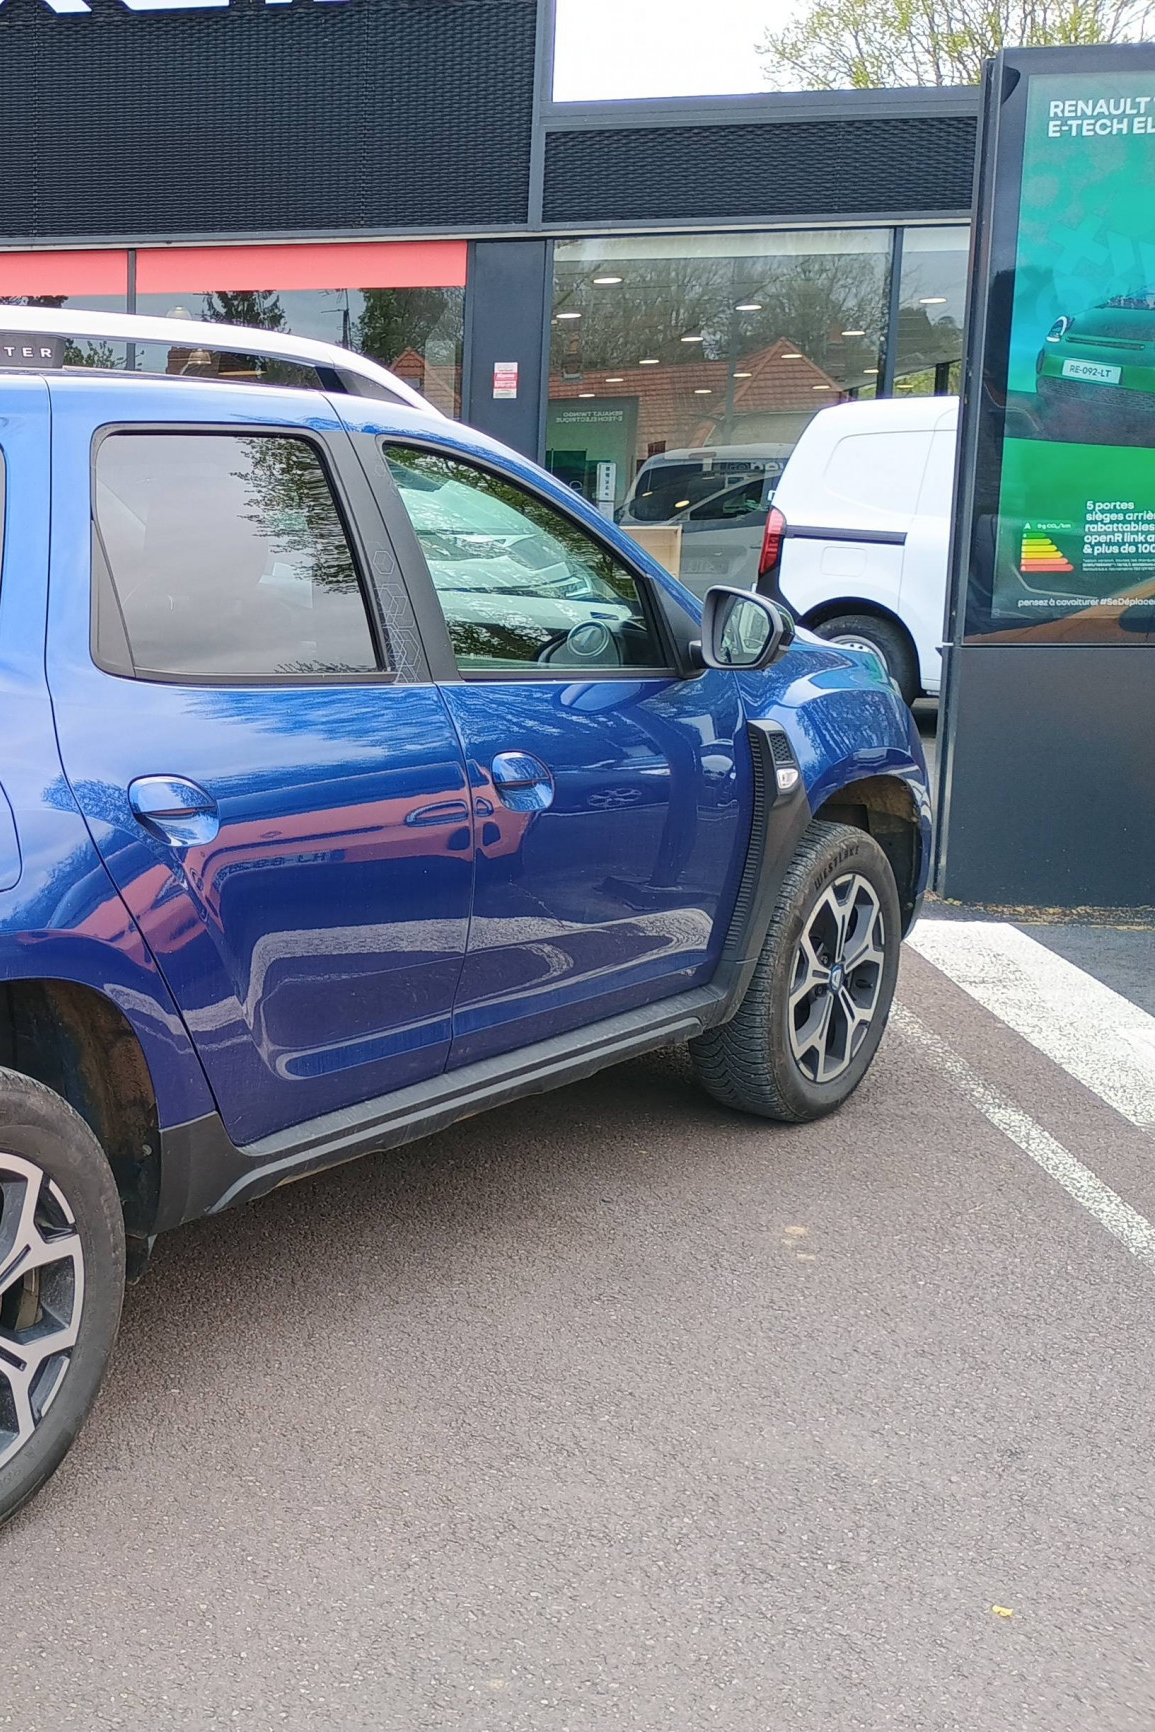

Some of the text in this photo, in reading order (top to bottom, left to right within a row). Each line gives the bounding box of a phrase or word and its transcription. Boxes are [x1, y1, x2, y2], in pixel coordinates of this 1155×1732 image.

[1049, 97, 1151, 117] RENAULT
[1048, 117, 1128, 137] E-TECH
[1069, 364, 1112, 378] RE-092-LT
[1086, 501, 1135, 512] 5 portes
[1086, 511, 1125, 523] sièges
[1084, 521, 1155, 533] rabattables
[1083, 533, 1123, 545] openR
[1123, 532, 1146, 543] link
[1082, 544, 1093, 554] &
[1094, 544, 1120, 556] plus
[1120, 543, 1137, 553] de
